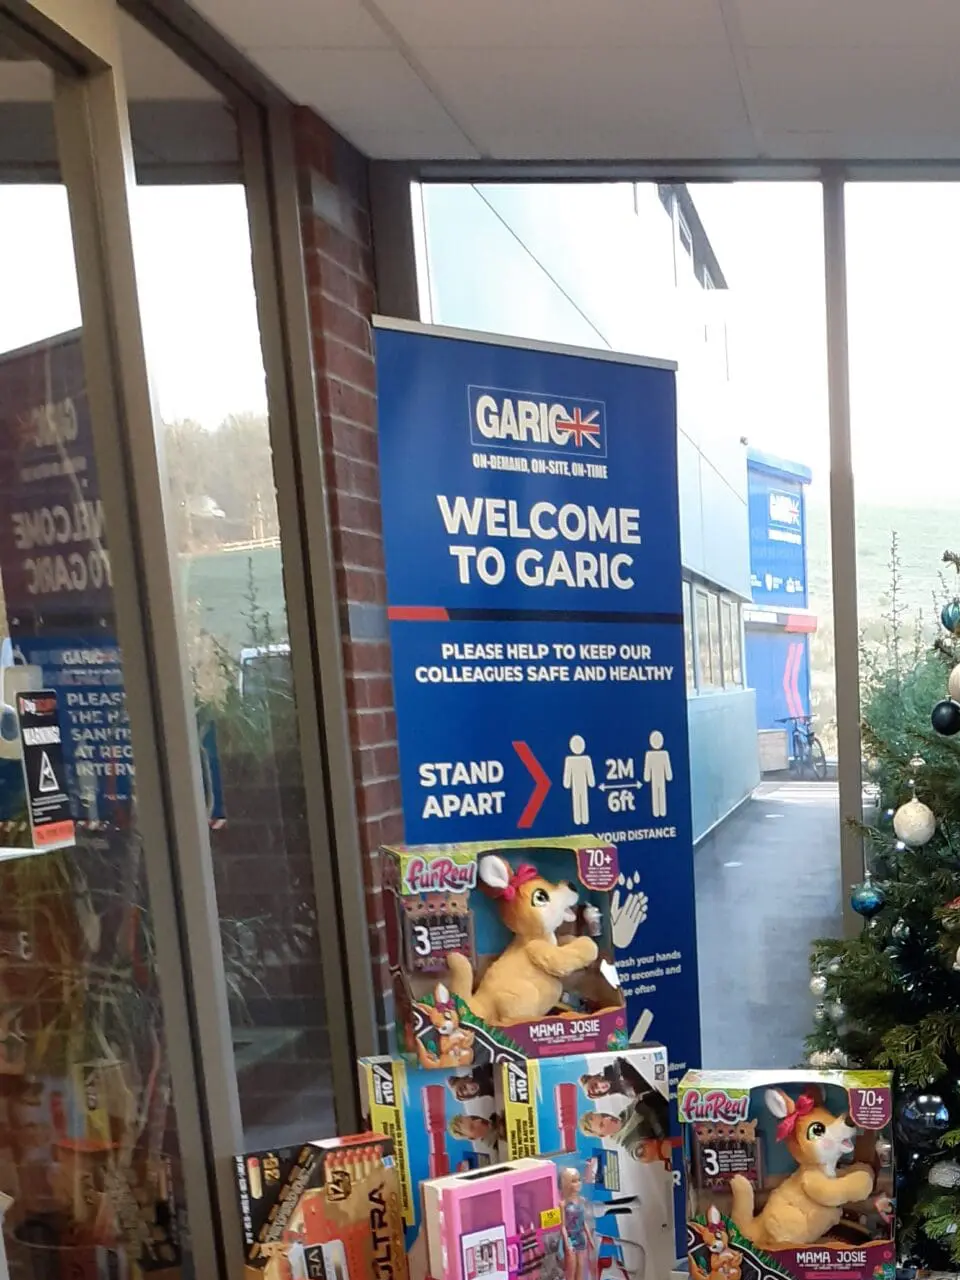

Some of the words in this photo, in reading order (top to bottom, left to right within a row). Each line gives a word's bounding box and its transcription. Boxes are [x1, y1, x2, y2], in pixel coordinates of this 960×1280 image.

[476, 395, 571, 446] GARIC
[437, 495, 641, 544] WELCOME
[449, 545, 505, 585] TO
[516, 549, 635, 590] GARIC
[441, 643, 504, 661] PLEASE
[507, 643, 549, 661] HELP
[552, 644, 576, 661] TO
[580, 643, 617, 661] KEEP
[620, 643, 652, 660] OUR
[415, 665, 524, 684] COLLEAGUES
[527, 666, 570, 682] SAFE
[573, 666, 607, 682] AND
[609, 666, 675, 682] HEALTHY
[66, 691, 128, 707] PLEAS
[418, 760, 505, 787] STAND
[606, 758, 635, 780] 2M
[422, 790, 506, 820] APART
[607, 789, 637, 813] 6ft
[598, 831, 627, 844] YOUR
[627, 827, 677, 842] DISTANCE
[585, 849, 613, 867] 70+
[414, 925, 432, 955] 3
[637, 954, 655, 967] your
[656, 951, 681, 962] hands
[665, 965, 682, 975] and
[529, 1022, 566, 1038] MAMA
[570, 1019, 601, 1034] JOSIE
[857, 1090, 885, 1107] 70+
[704, 1148, 719, 1176] 3
[796, 1251, 832, 1264] MAMA
[837, 1251, 867, 1264] JOSIE
